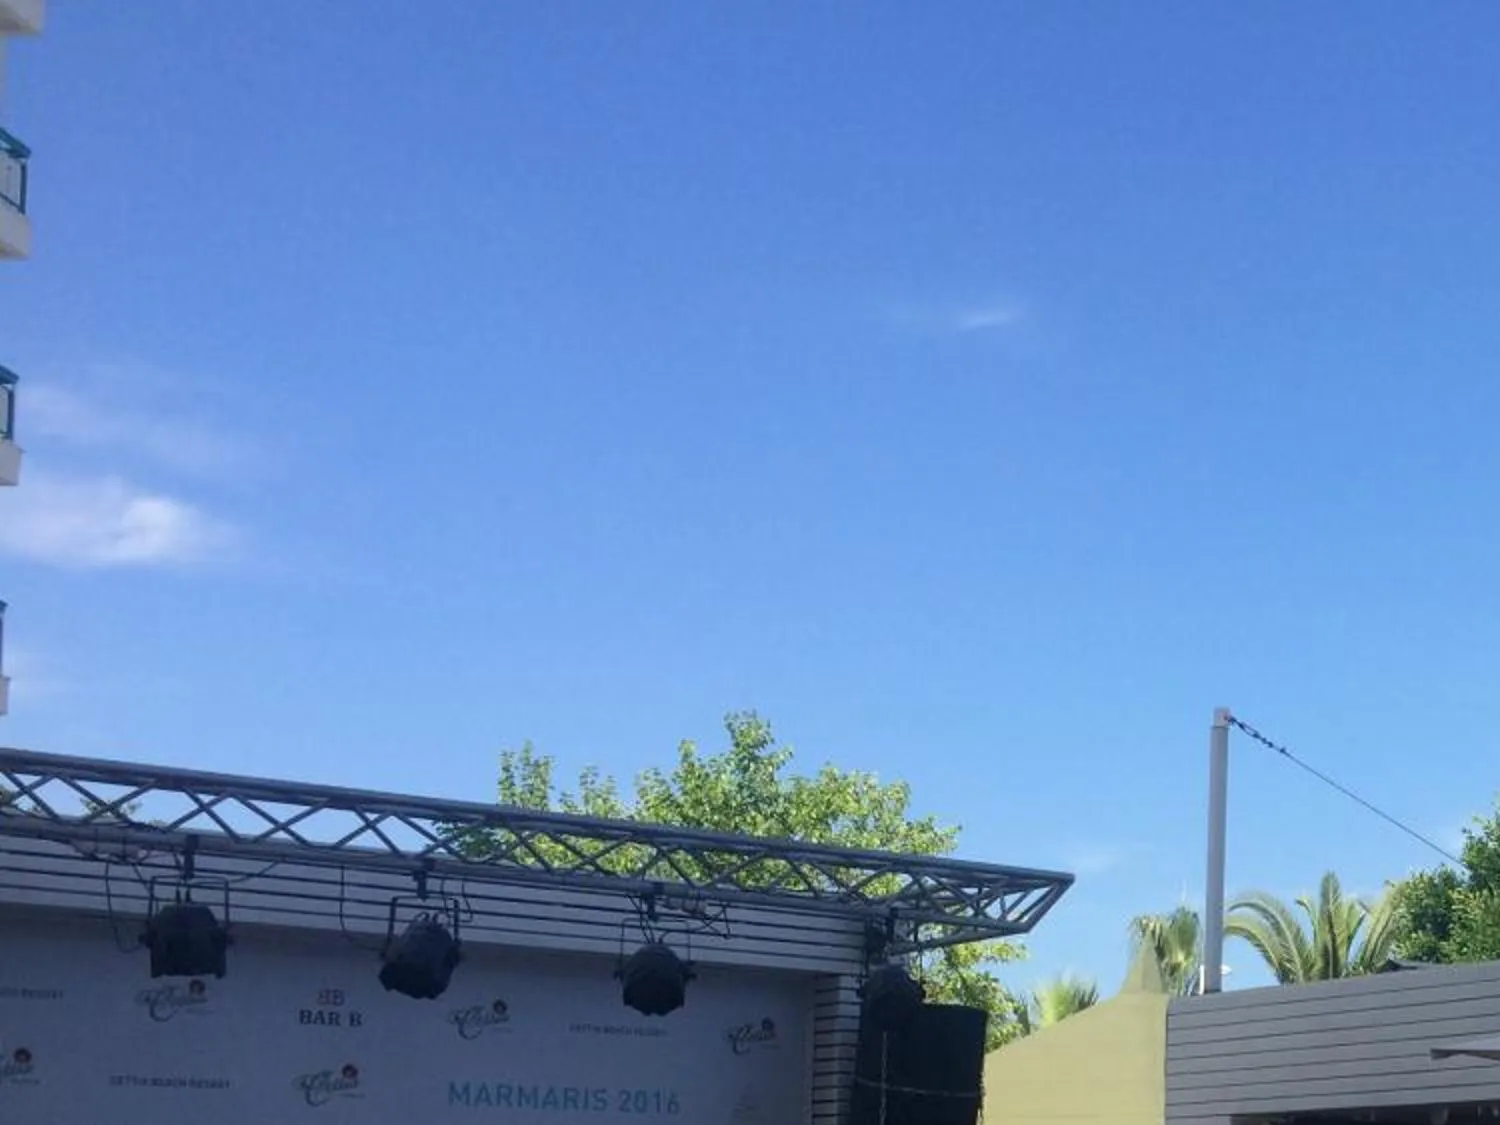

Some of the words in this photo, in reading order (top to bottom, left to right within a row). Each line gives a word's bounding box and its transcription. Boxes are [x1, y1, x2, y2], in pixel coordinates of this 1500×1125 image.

[299, 1009, 341, 1027] BAR
[349, 1011, 363, 1028] B
[447, 1080, 607, 1113] MARMARIS
[618, 1088, 681, 1116] 2016
